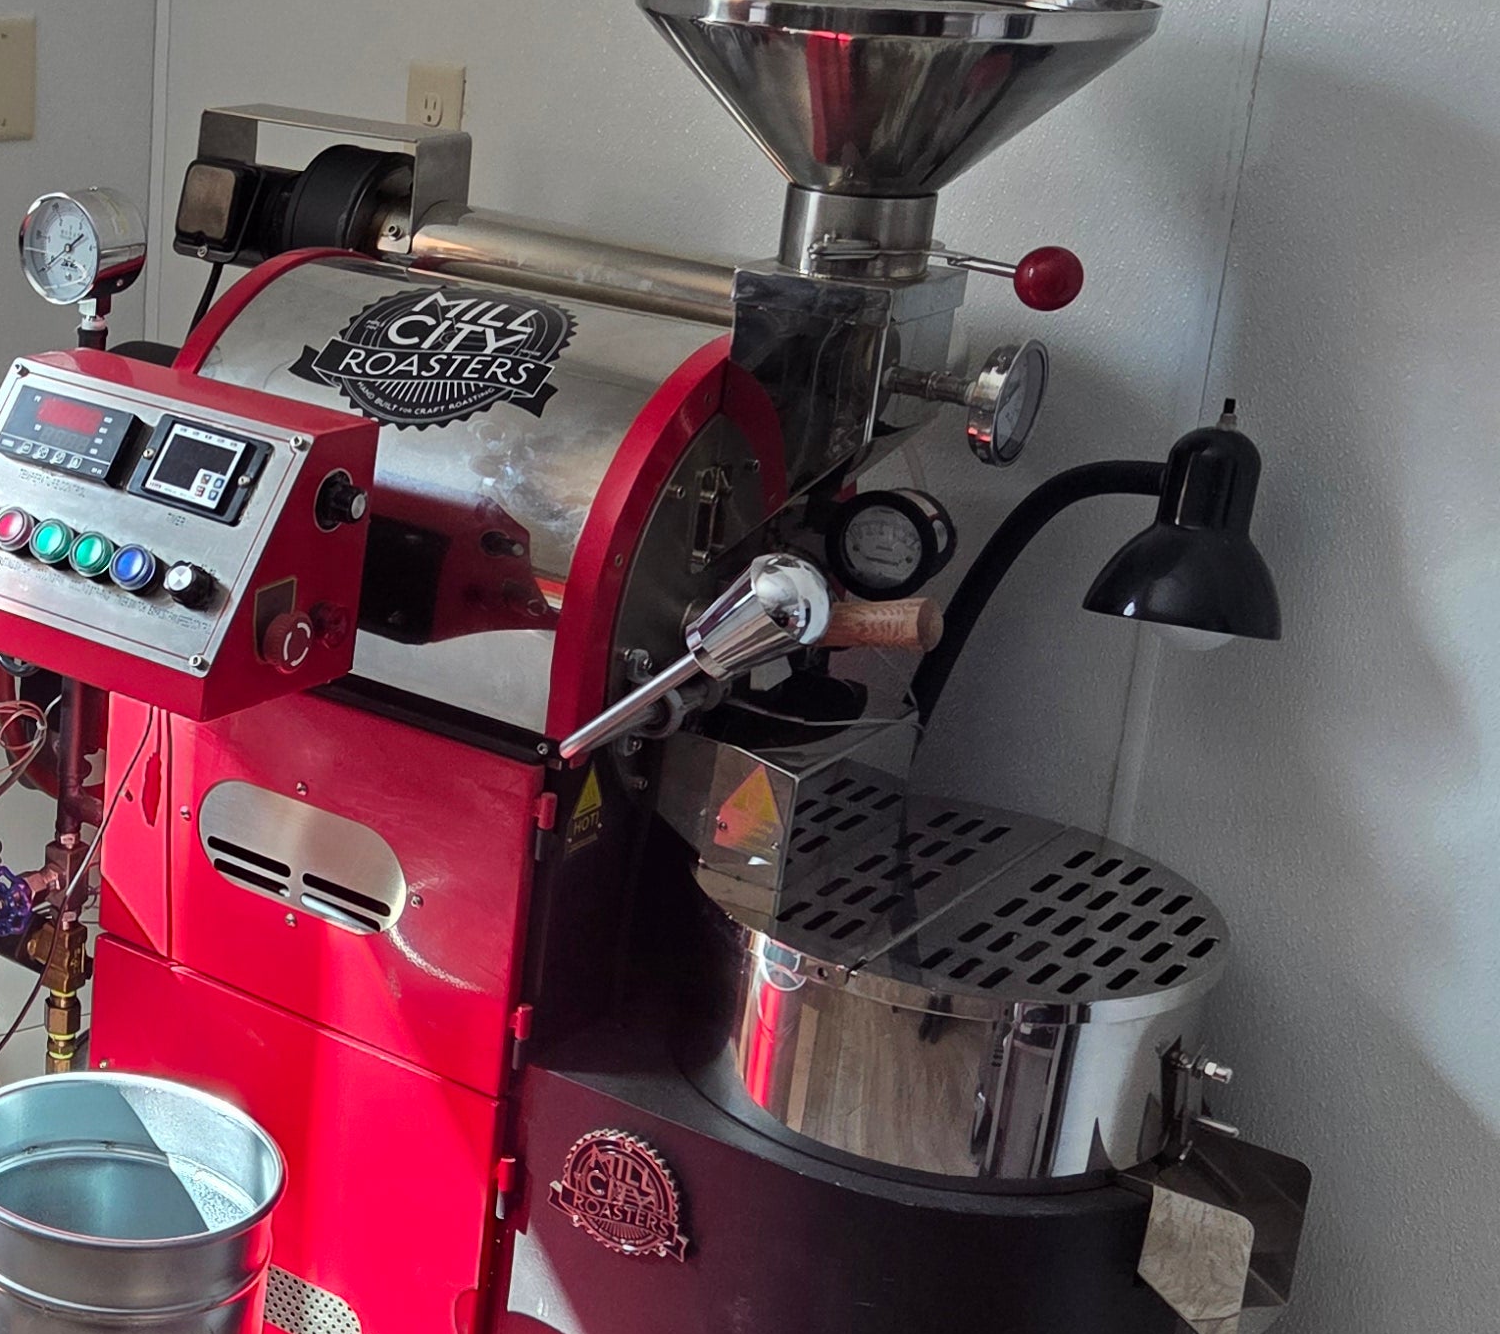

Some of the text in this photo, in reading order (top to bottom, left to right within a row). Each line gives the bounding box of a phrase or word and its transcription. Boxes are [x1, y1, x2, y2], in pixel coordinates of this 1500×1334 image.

[411, 290, 540, 333] MILL
[387, 314, 529, 354] CITY
[337, 347, 535, 386] ROASTERS
[356, 380, 376, 400] HAND
[374, 397, 398, 412] BUILT
[413, 405, 447, 415] CRAFT
[448, 386, 496, 410] ROASTING
[589, 1144, 657, 1194] MILL
[572, 1192, 670, 1238] ROASTERS
